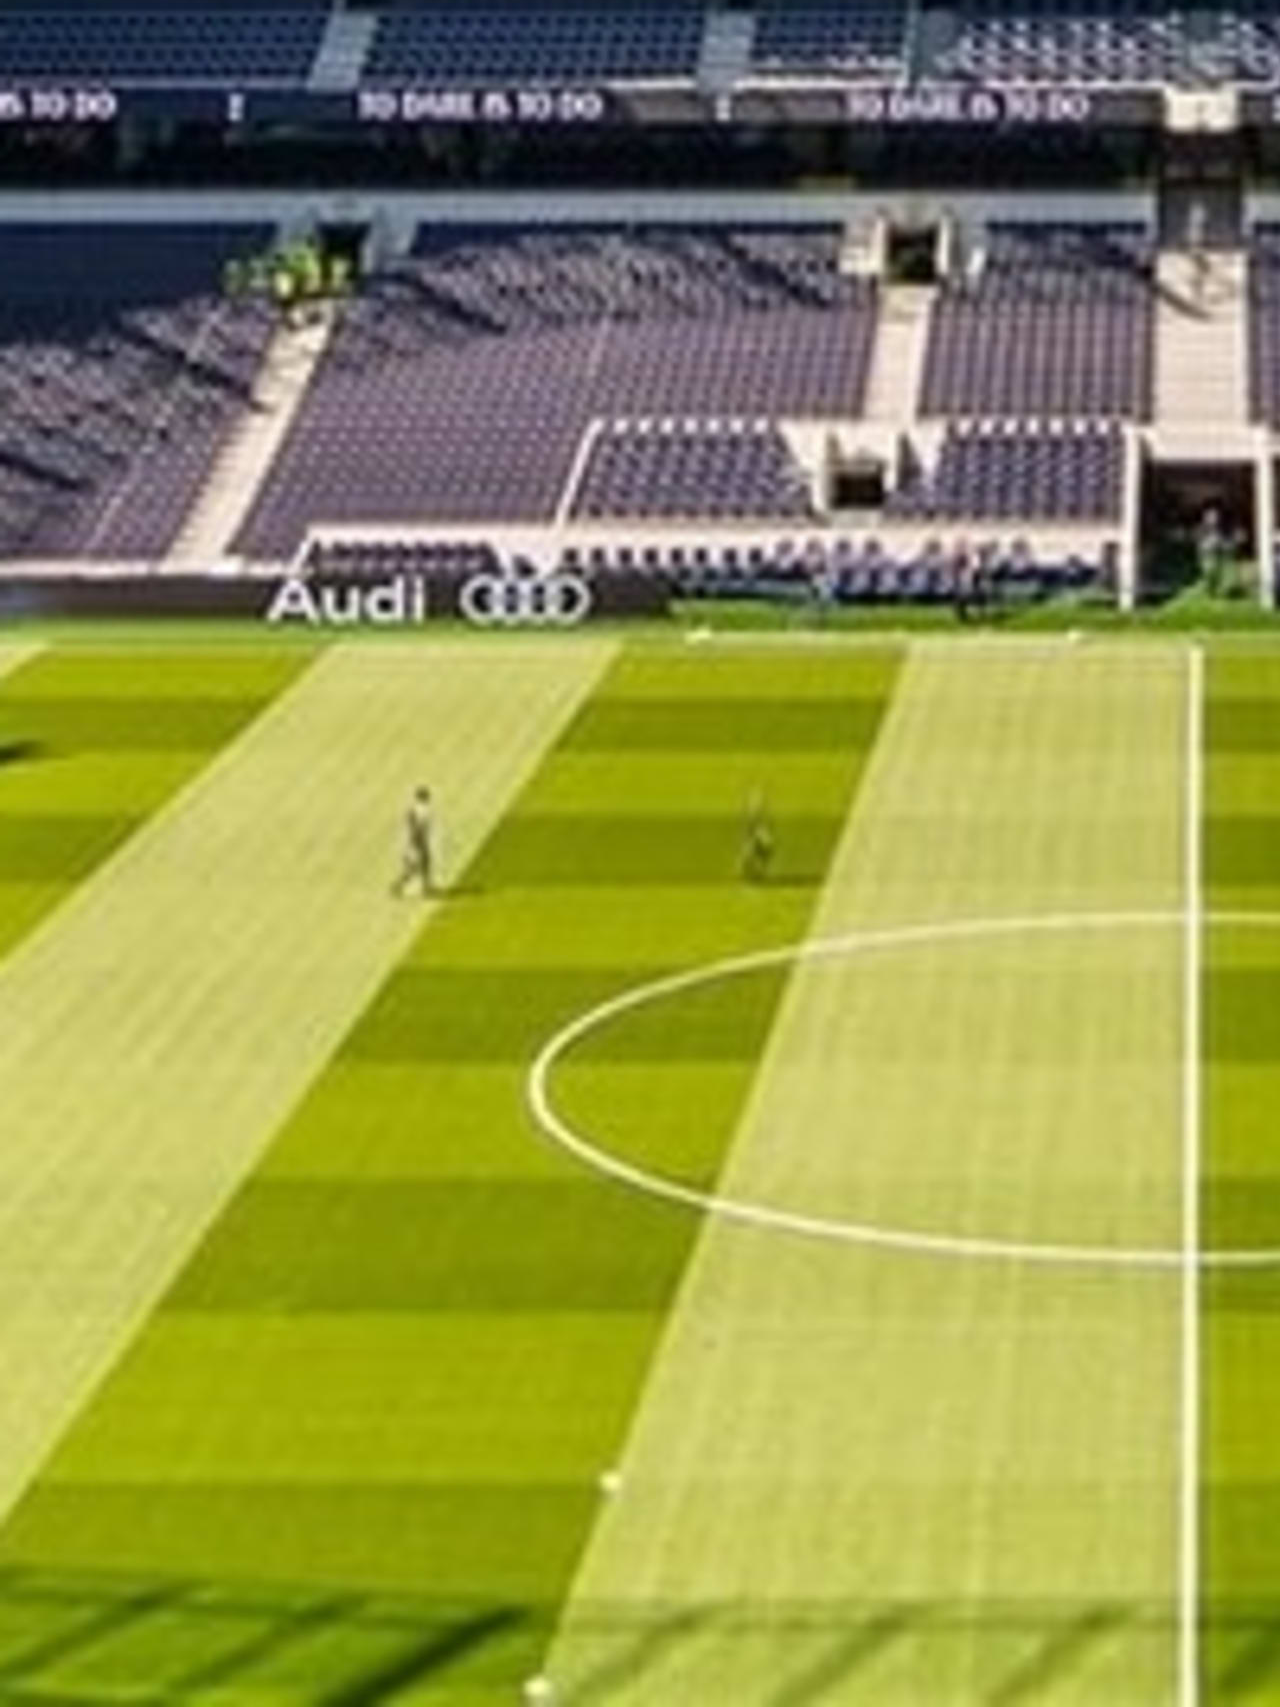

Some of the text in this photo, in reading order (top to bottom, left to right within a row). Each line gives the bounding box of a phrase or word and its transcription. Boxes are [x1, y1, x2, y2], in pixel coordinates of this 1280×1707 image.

[31, 91, 66, 121] TO
[75, 91, 117, 121] DO
[358, 91, 398, 121] TO
[516, 91, 553, 121] TO
[558, 91, 603, 121] DO
[849, 91, 885, 121] TO
[1003, 91, 1038, 121] TO
[1047, 91, 1090, 121] DO
[267, 576, 424, 622] Audi
